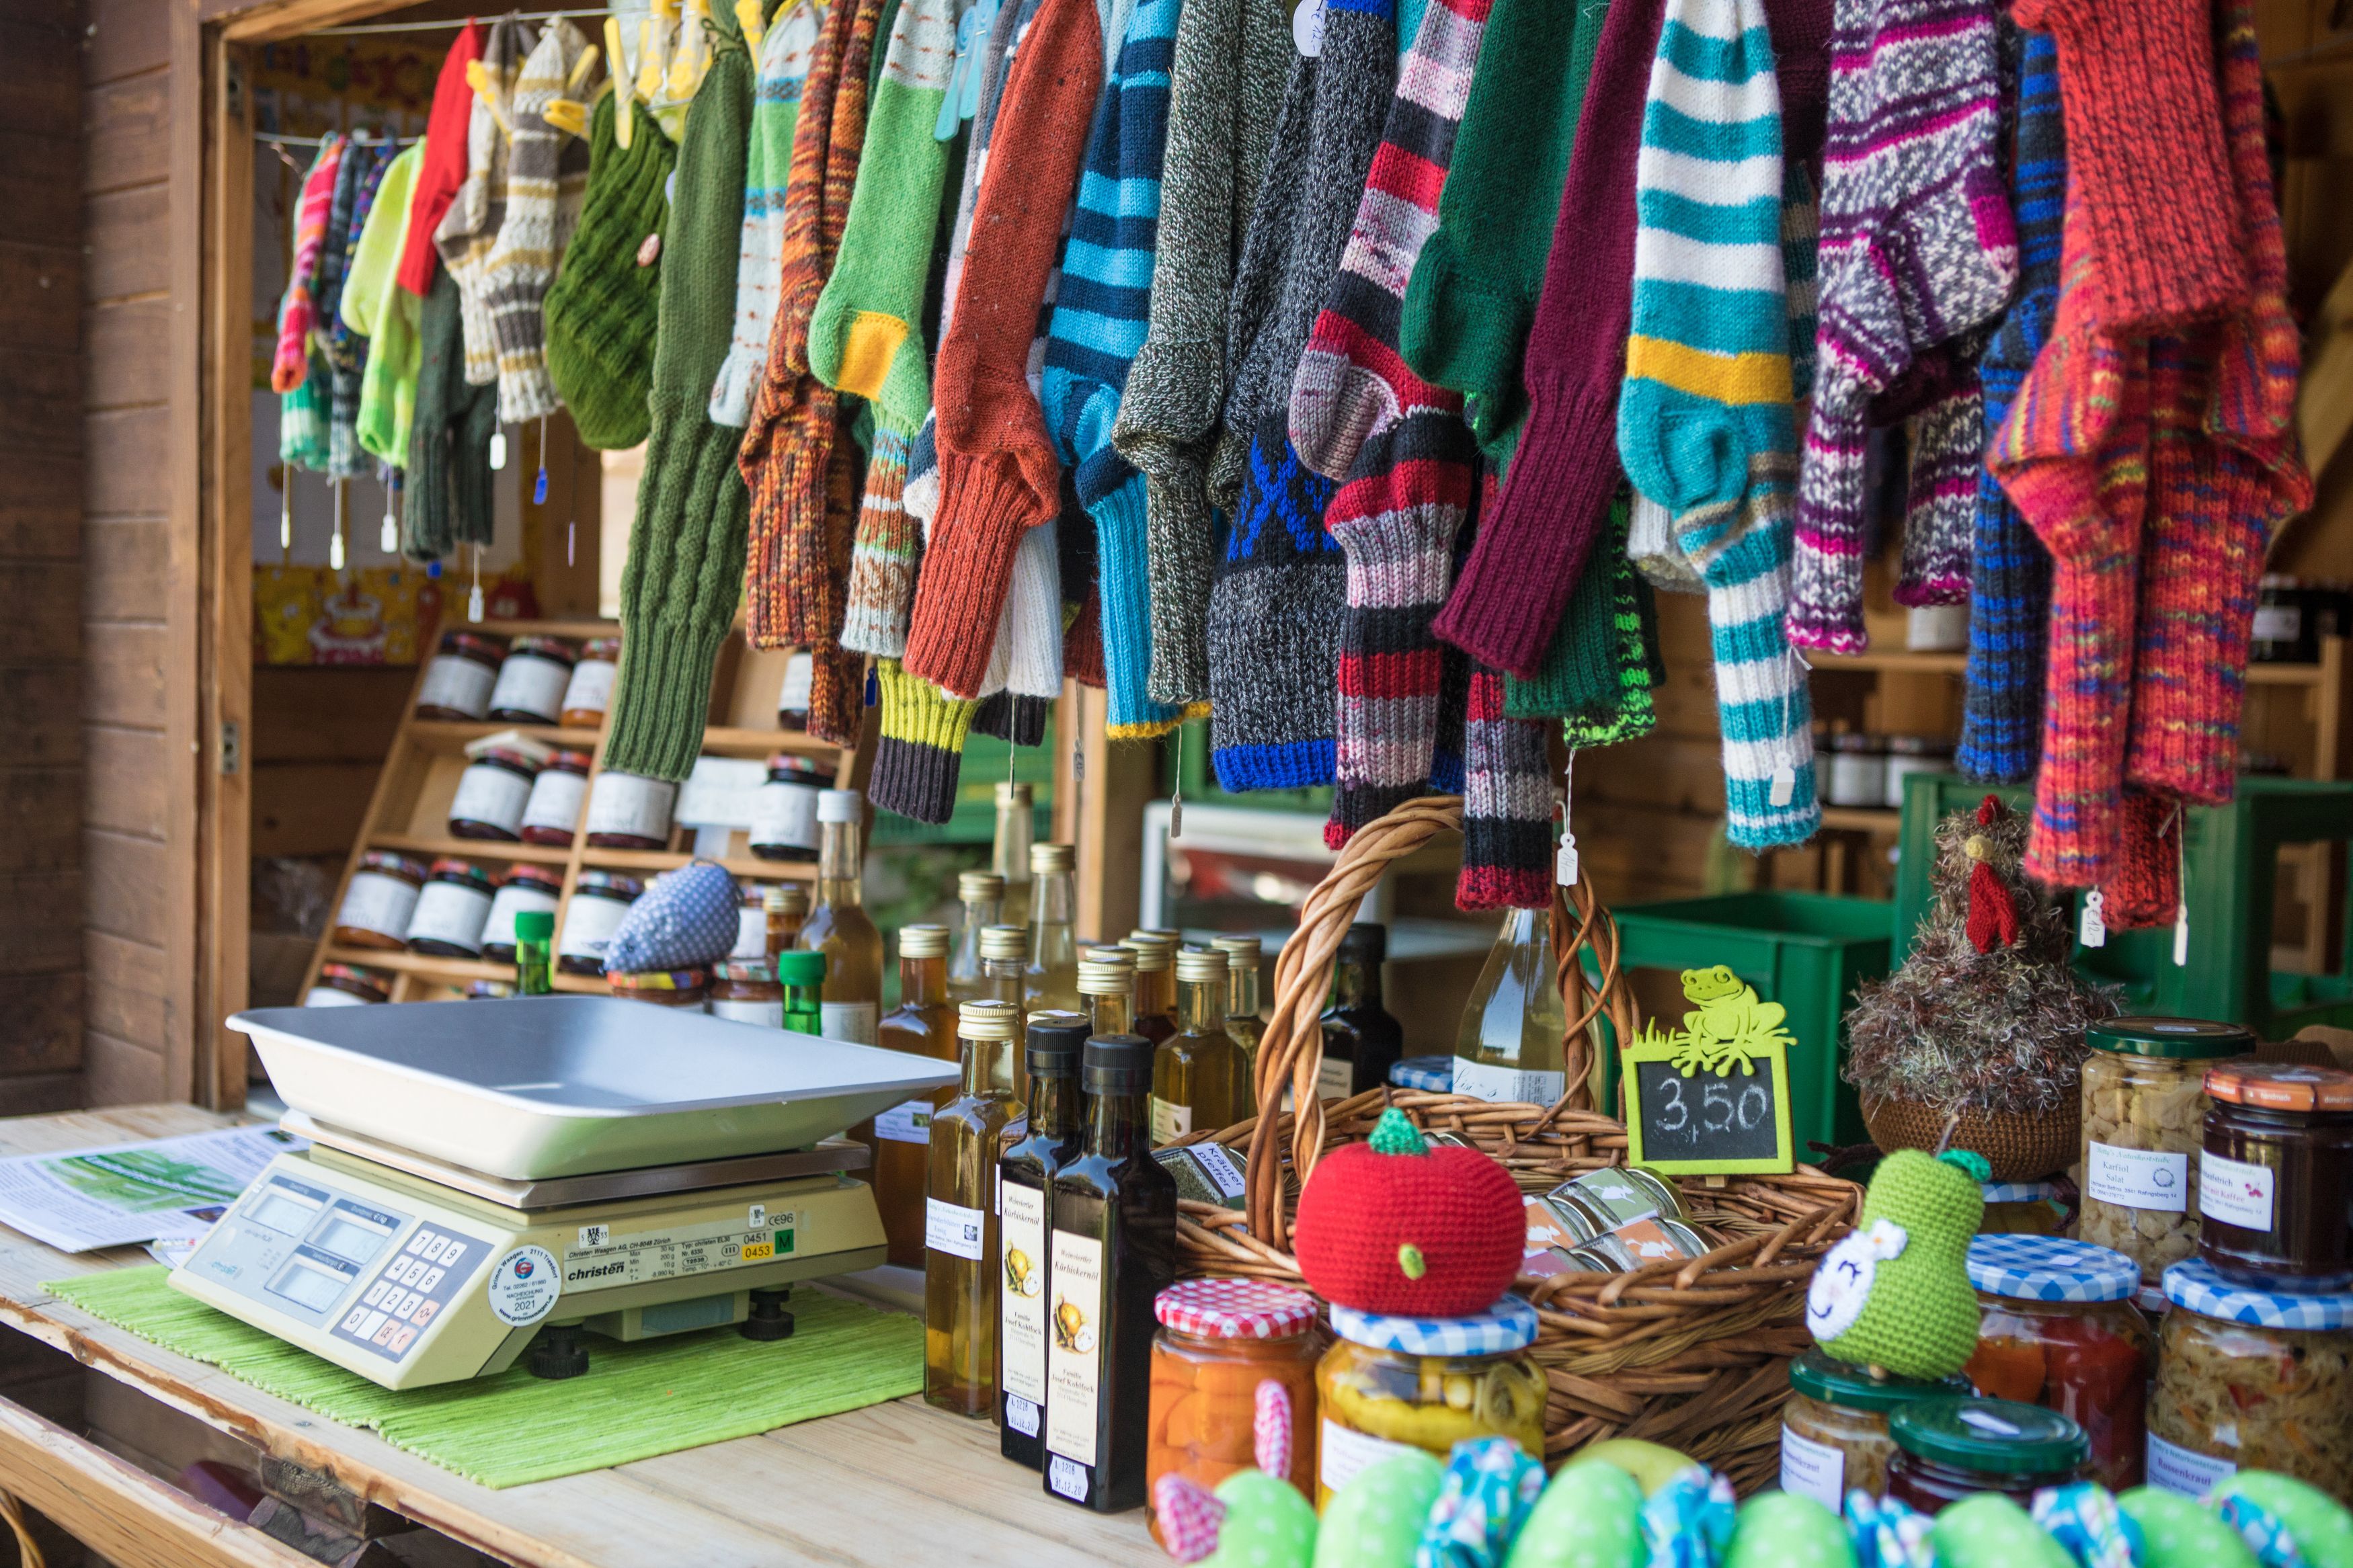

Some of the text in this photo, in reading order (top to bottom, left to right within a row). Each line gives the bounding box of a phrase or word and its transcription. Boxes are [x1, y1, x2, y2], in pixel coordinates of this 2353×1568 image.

[1655, 1077, 1766, 1144] 3,50
[1197, 1152, 1230, 1188] pfeffer
[1208, 1147, 1242, 1187] Kräuter
[2103, 1161, 2129, 1173] Karfiol
[2106, 1174, 2124, 1183] Salat
[2138, 1190, 2169, 1198] Rafingsberg
[1008, 1196, 1033, 1209] Weinviertler
[1004, 1207, 1039, 1226] Kürbiskernöl
[744, 1233, 766, 1244] 0451
[779, 1235, 790, 1248] M
[415, 1237, 457, 1260] 7 8 9
[569, 1250, 592, 1258] Christen
[594, 1247, 616, 1255] Waagen
[746, 1245, 770, 1258] 0453
[1062, 1249, 1092, 1264] Weinviertler
[395, 1263, 435, 1285] 4 5 6
[492, 1268, 502, 1290] Grimm
[502, 1250, 523, 1267] Waagen
[544, 1255, 557, 1278] Tresdorf
[568, 1265, 624, 1280] christen
[1055, 1260, 1099, 1280] Kürbiskernöl
[373, 1288, 381, 1298] 1
[387, 1294, 397, 1305] 2
[403, 1301, 413, 1311] 3
[507, 1288, 543, 1298] NACHEICHUNG
[515, 1301, 535, 1311] 2021
[1015, 1311, 1030, 1321] Familie
[1005, 1317, 1041, 1335] Josef Kohlfock
[1064, 1368, 1082, 1379] Familie
[1051, 1374, 1094, 1393] Josef Kohlfock
